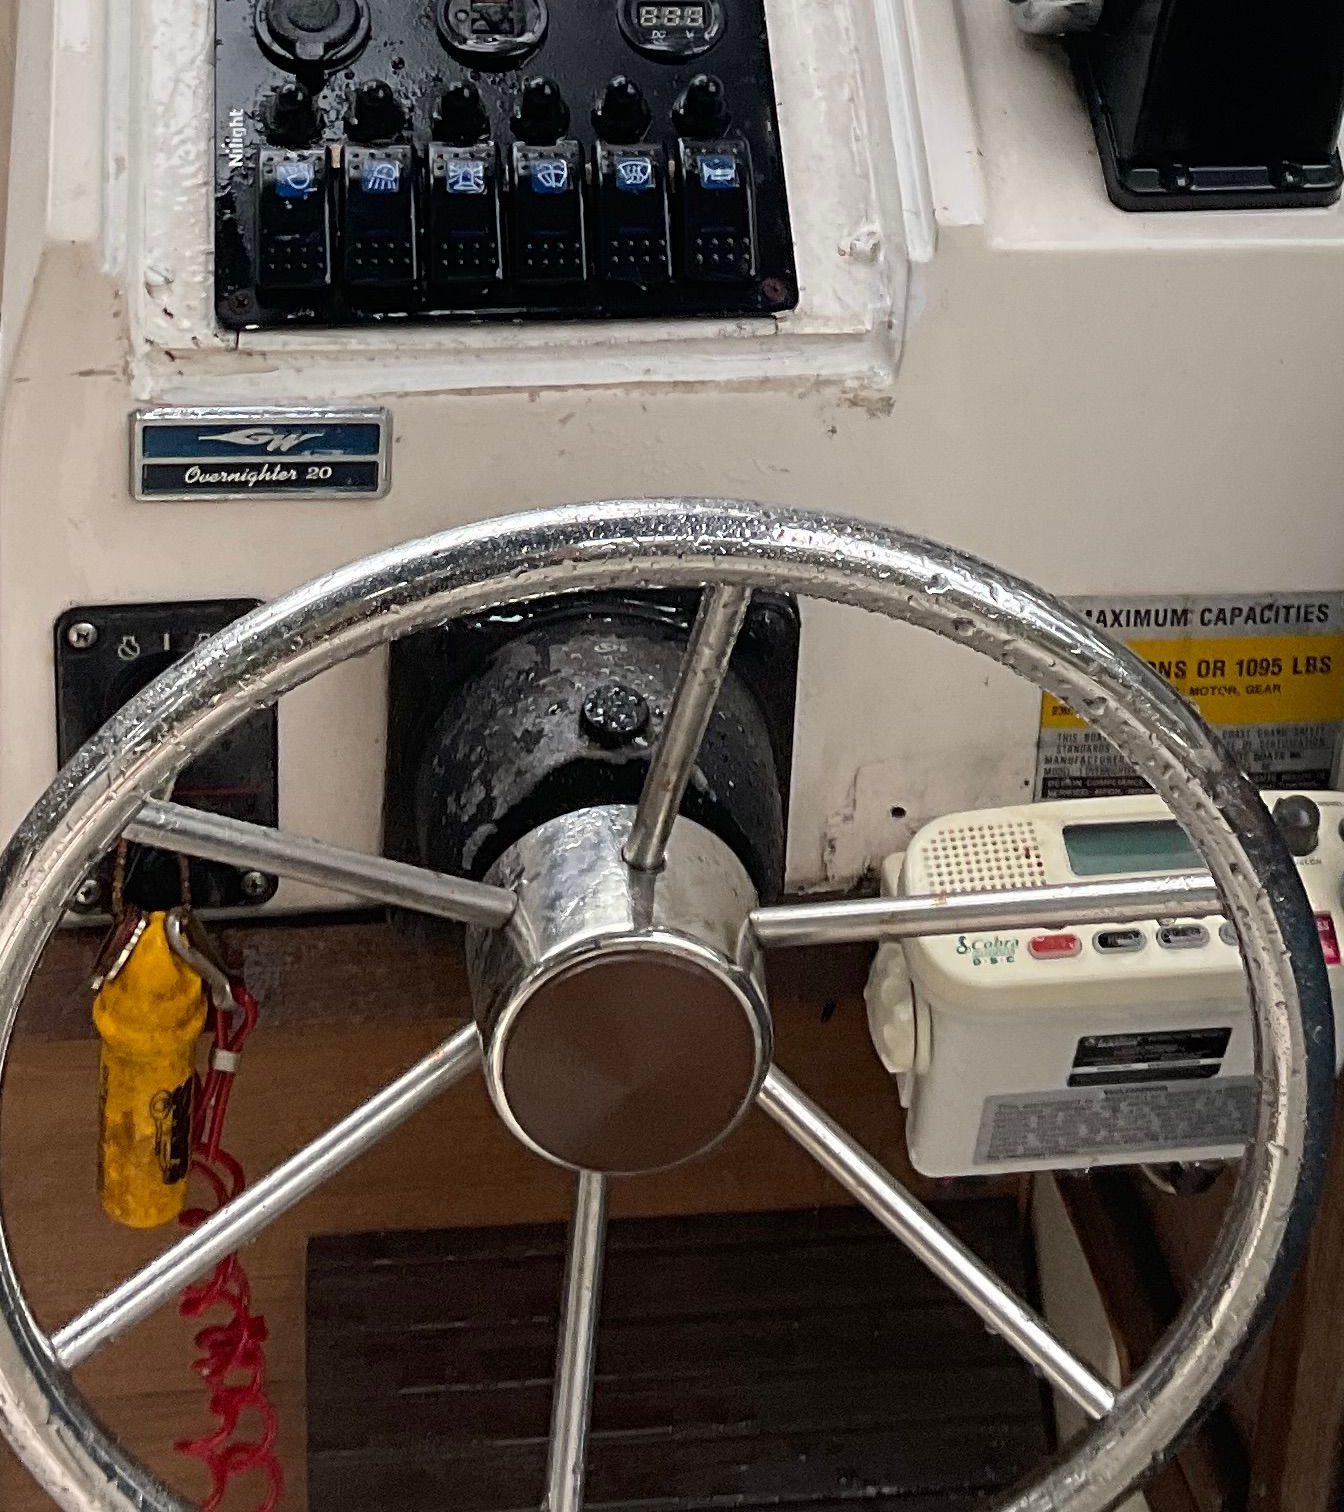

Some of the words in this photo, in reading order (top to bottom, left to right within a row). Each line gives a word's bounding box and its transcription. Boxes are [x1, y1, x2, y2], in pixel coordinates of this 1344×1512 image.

[220, 108, 247, 167] Nilight
[184, 463, 298, 487] Overnighter
[305, 465, 333, 480] 20
[1085, 608, 1189, 629] AXIMUM
[1199, 603, 1330, 626] CAPACITIES
[1197, 660, 1226, 678] OR
[1235, 657, 1283, 678] 1095
[1292, 655, 1332, 675] LBS
[1245, 683, 1282, 696] GEAR
[971, 936, 1020, 950] Cobra
